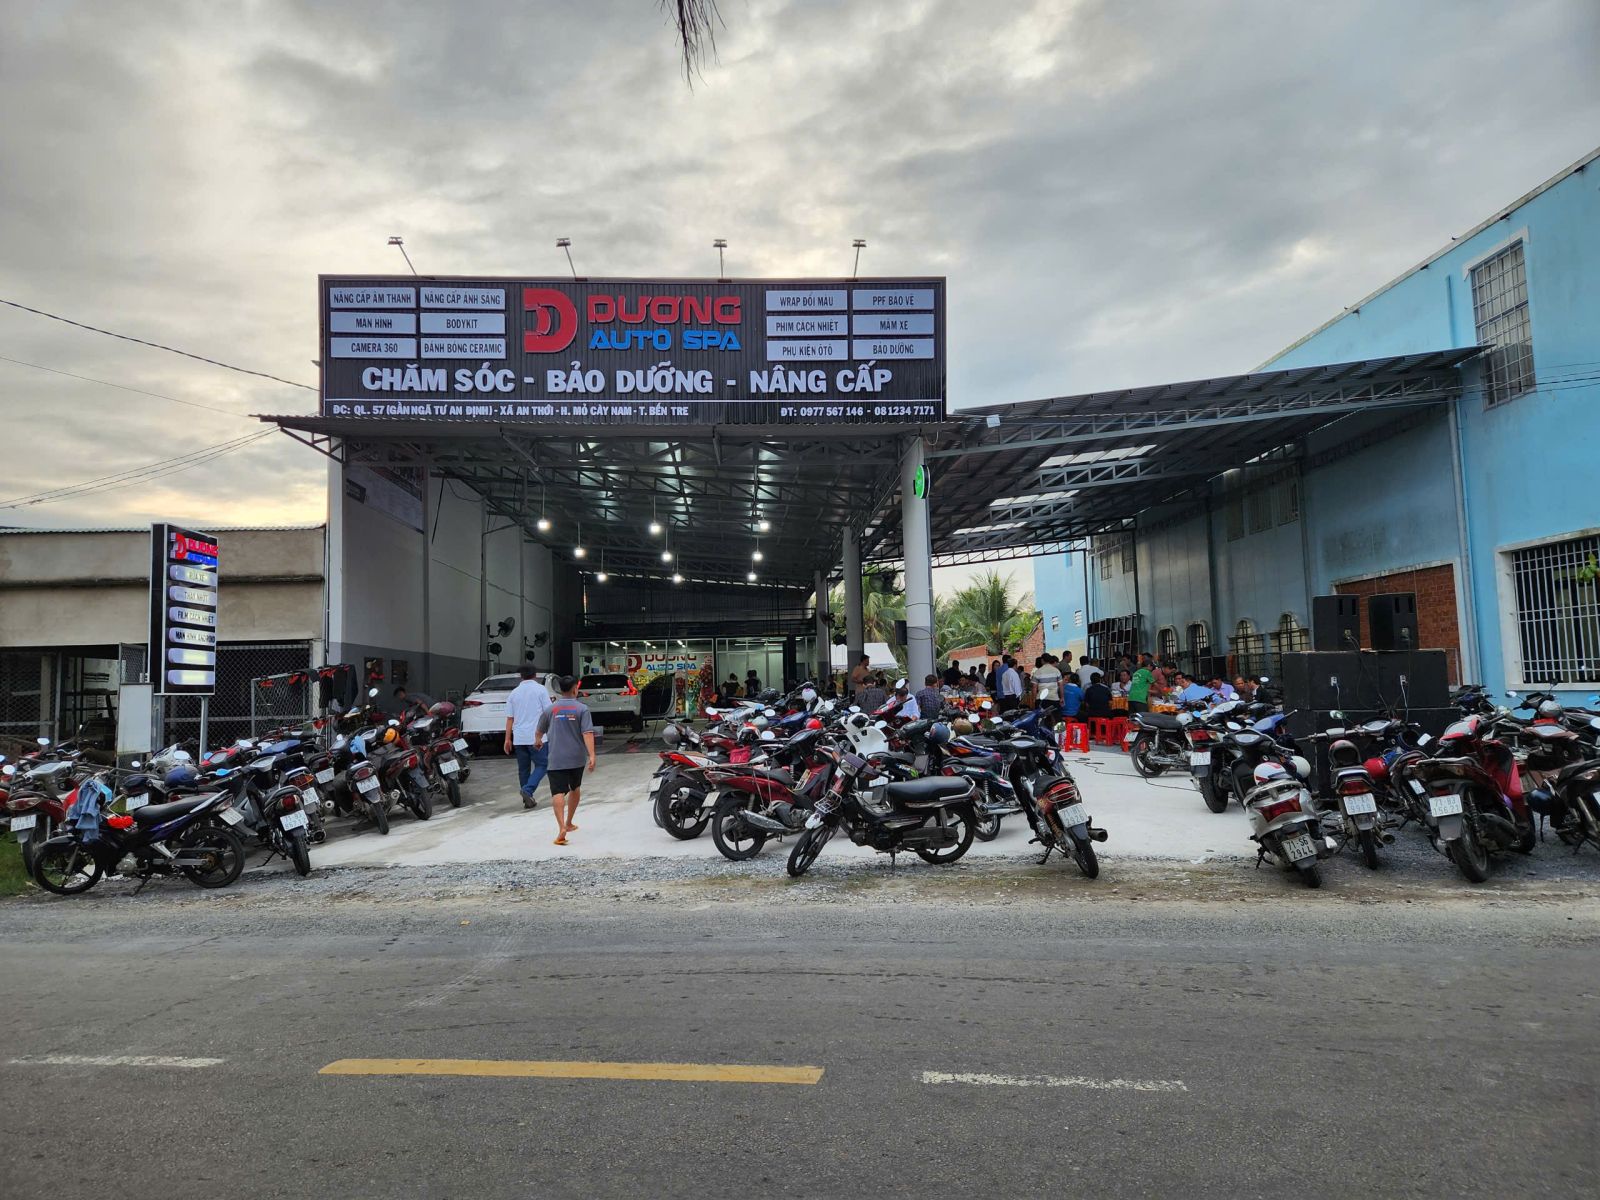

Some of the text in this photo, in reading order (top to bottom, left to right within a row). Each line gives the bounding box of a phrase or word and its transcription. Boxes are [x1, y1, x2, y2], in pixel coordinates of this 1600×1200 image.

[356, 290, 370, 303] CẤP
[386, 294, 411, 303] THANH
[447, 290, 461, 304] CẤP
[780, 296, 800, 306] WRAP
[872, 296, 886, 305] PPF
[588, 295, 741, 324] DƯƠNG
[446, 319, 478, 328] BODYKIT
[776, 319, 838, 333] PHIM CÁCH NHIỆT
[900, 321, 908, 330] XE
[590, 329, 741, 350] AUTO SPA
[351, 343, 398, 352] CAMERA 360
[424, 340, 502, 353] ĐÁNH BÓNG CERAMIC
[782, 346, 796, 357] PHỤ
[800, 344, 816, 357] KIỆN
[890, 342, 914, 354] DƯỠNG
[362, 363, 447, 392] CHĂM
[454, 361, 516, 392] SÓC
[547, 361, 605, 393] BẢO
[616, 361, 713, 393] DƯỠNG
[750, 365, 827, 393] NÂNG
[836, 360, 893, 392] CẤP
[333, 405, 350, 415] ĐC:
[354, 405, 370, 416] QL.
[373, 405, 385, 415] 57
[386, 402, 411, 415] (GẦN
[412, 404, 432, 415] NGÃ
[434, 405, 447, 415] TƯ
[449, 406, 462, 415] AN
[466, 405, 492, 417] ĐỊNH)
[500, 404, 513, 415] XÃ
[516, 406, 530, 416] AN
[561, 406, 570, 416] H.
[573, 404, 587, 416] MỎ
[590, 404, 609, 416] CÀY
[611, 406, 632, 416] NAM
[639, 406, 647, 416] T.
[650, 403, 668, 416] BẾN
[671, 406, 688, 416] TRE
[781, 407, 797, 416] ĐT:
[800, 407, 824, 416] 0977
[826, 407, 843, 416] 567
[846, 407, 863, 416] 146
[914, 406, 934, 415] 7171
[1286, 837, 1308, 850] 71-S6
[1291, 846, 1314, 860] 2944
